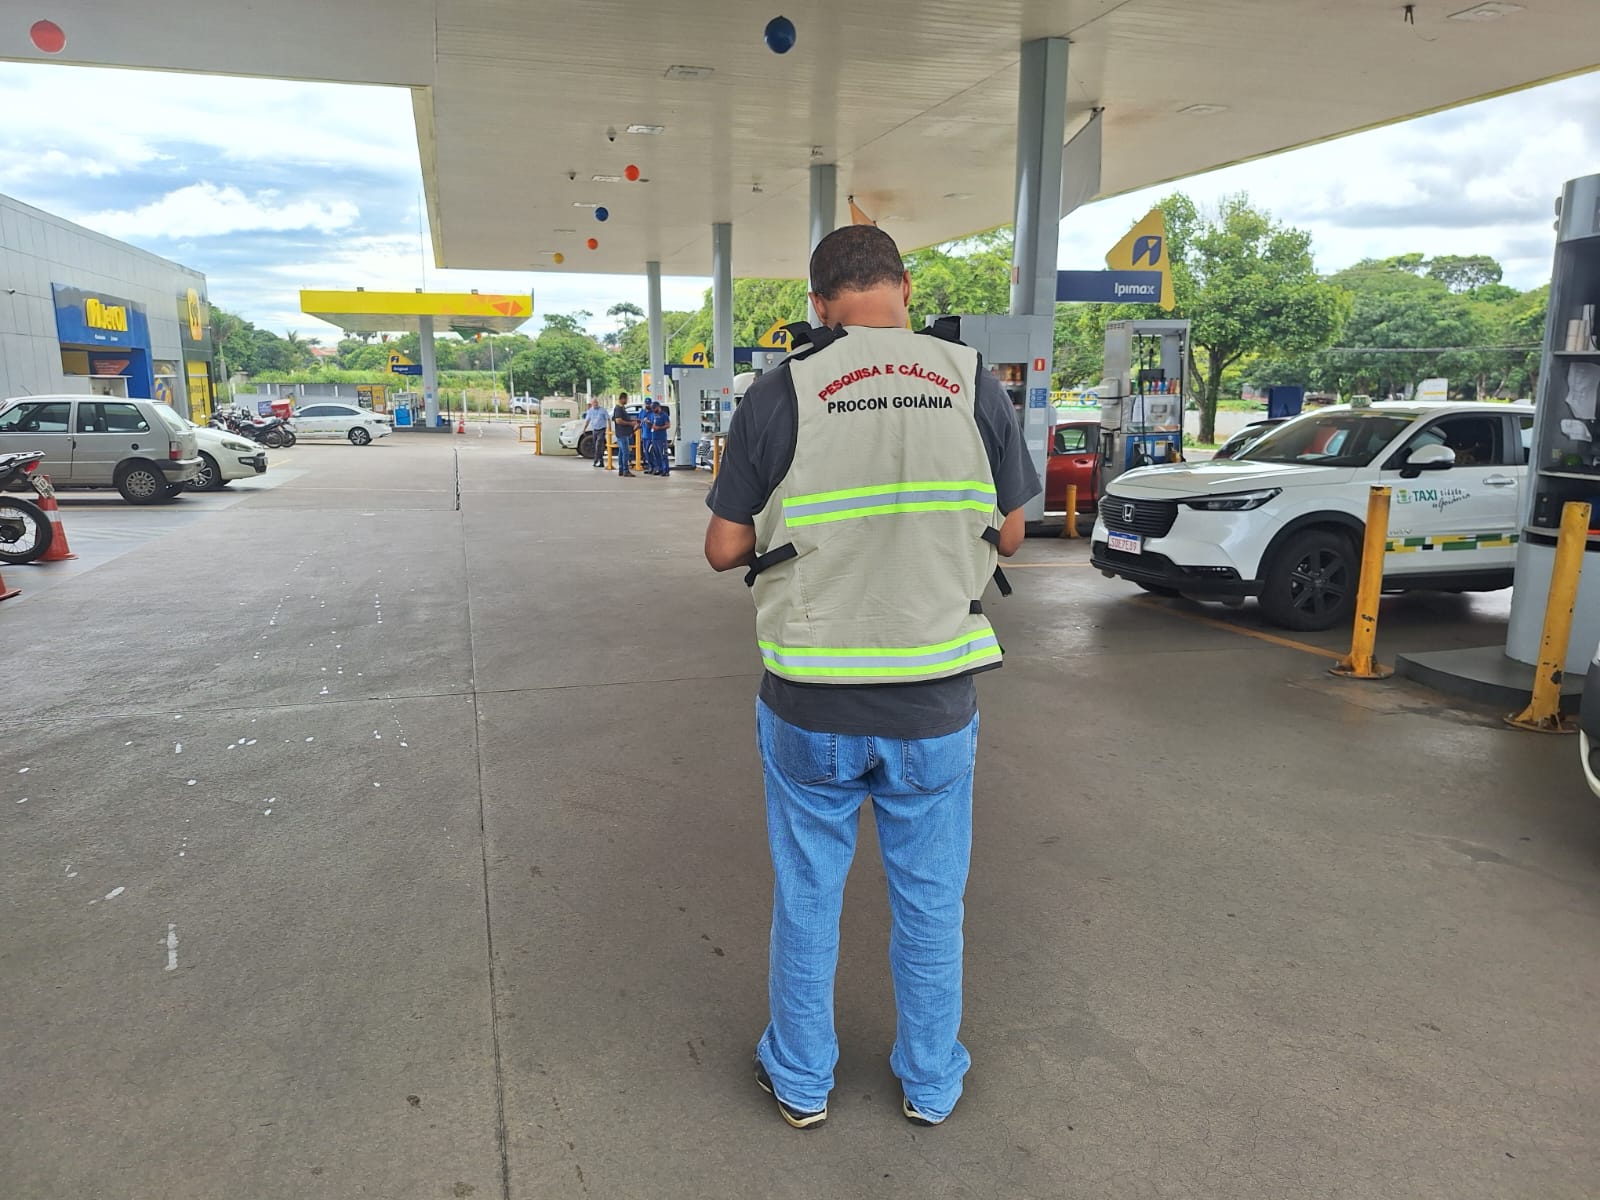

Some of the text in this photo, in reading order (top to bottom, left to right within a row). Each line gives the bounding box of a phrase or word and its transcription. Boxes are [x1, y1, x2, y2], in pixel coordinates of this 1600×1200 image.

[1114, 282, 1155, 297] Ipimax
[818, 363, 960, 402] PESQUISA E CÁLCULO
[827, 393, 953, 414] PROCON GOIÂNIA
[1412, 489, 1438, 502] TAXI
